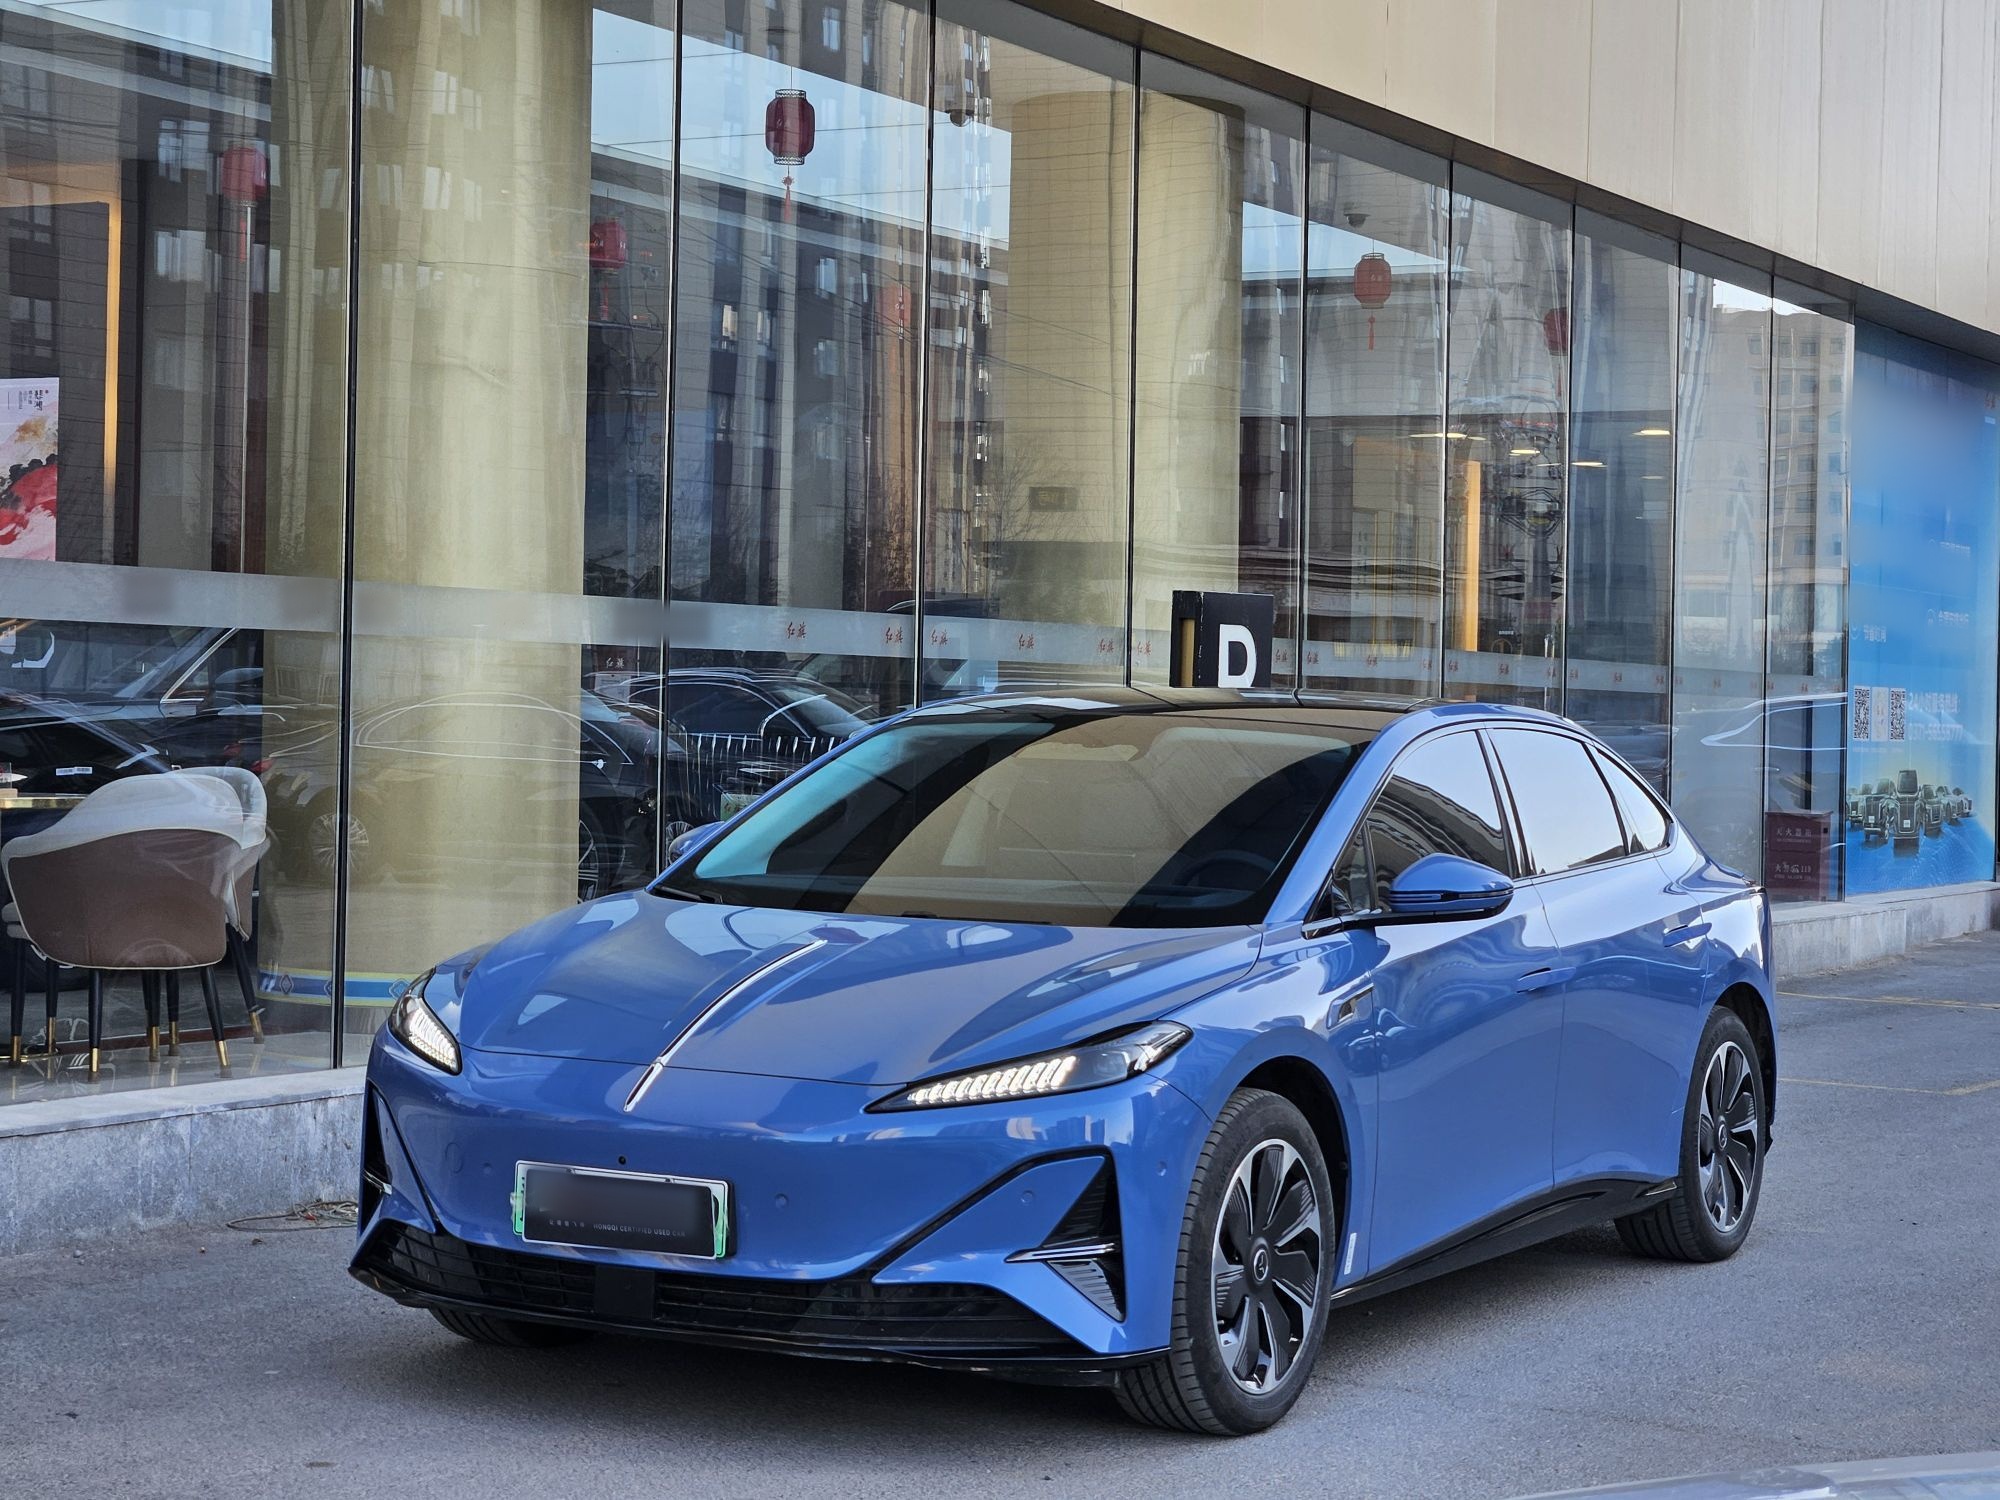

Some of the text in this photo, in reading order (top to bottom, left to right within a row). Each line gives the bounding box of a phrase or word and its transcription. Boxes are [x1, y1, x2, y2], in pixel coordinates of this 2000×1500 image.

[787, 621, 807, 639] 红旗
[1218, 624, 1257, 688] D
[593, 1223, 619, 1232] HONGQI
[619, 1225, 652, 1235] CERTIFIED
[653, 1228, 671, 1237] USED
